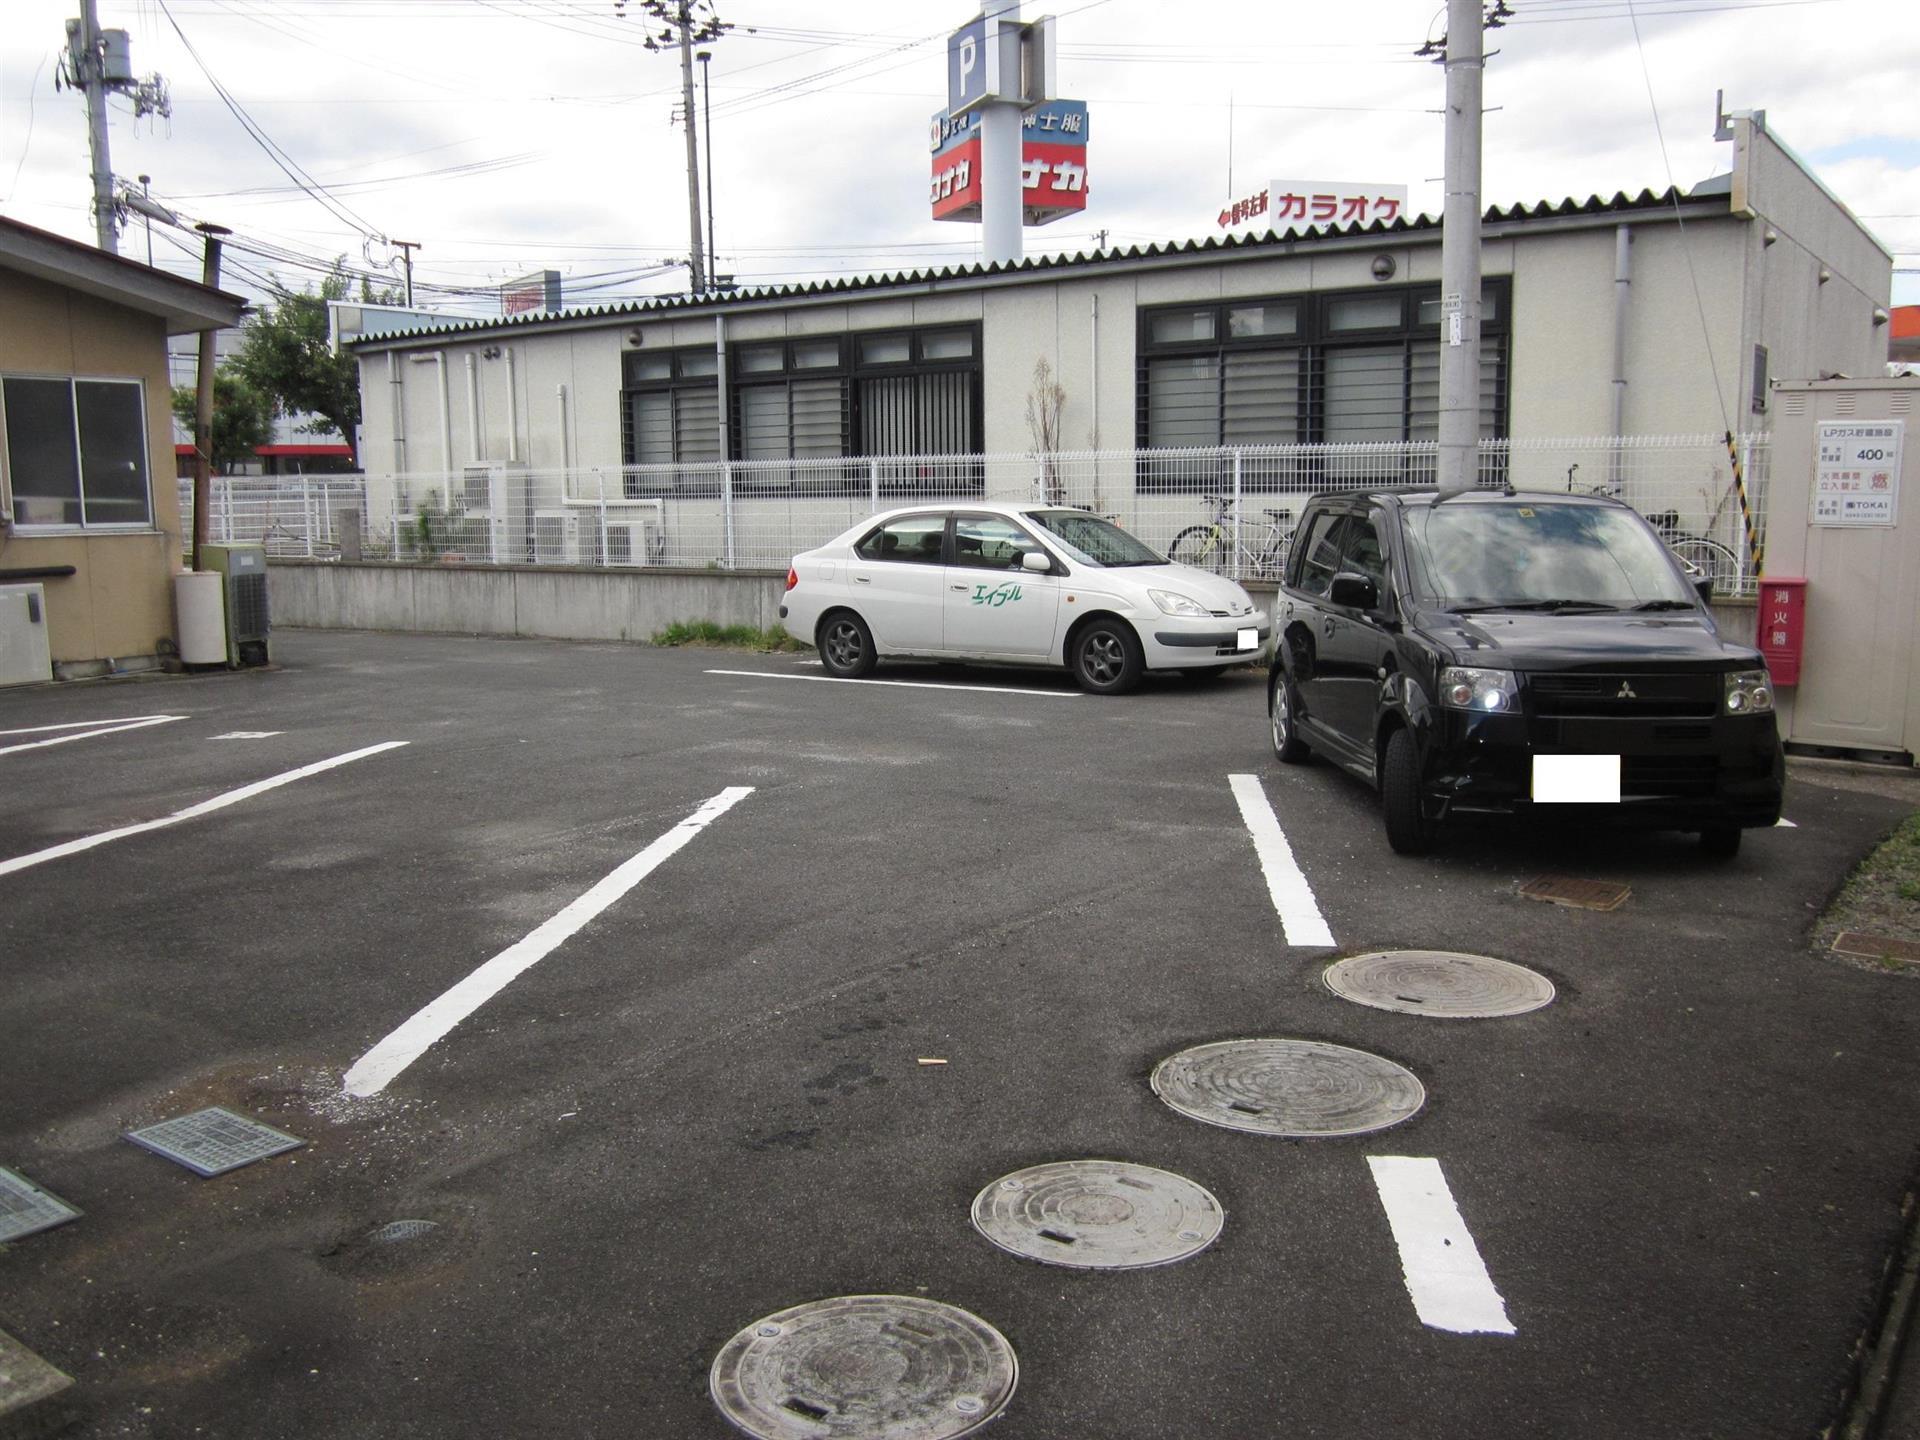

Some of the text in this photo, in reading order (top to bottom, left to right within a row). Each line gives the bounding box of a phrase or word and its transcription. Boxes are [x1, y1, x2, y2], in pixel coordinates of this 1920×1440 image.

[960, 35, 976, 97] P
[1278, 193, 1400, 221] カラオケ
[1857, 449, 1884, 461] 400
[972, 581, 1022, 607] エイブル
[1773, 590, 1789, 646] 消火器
